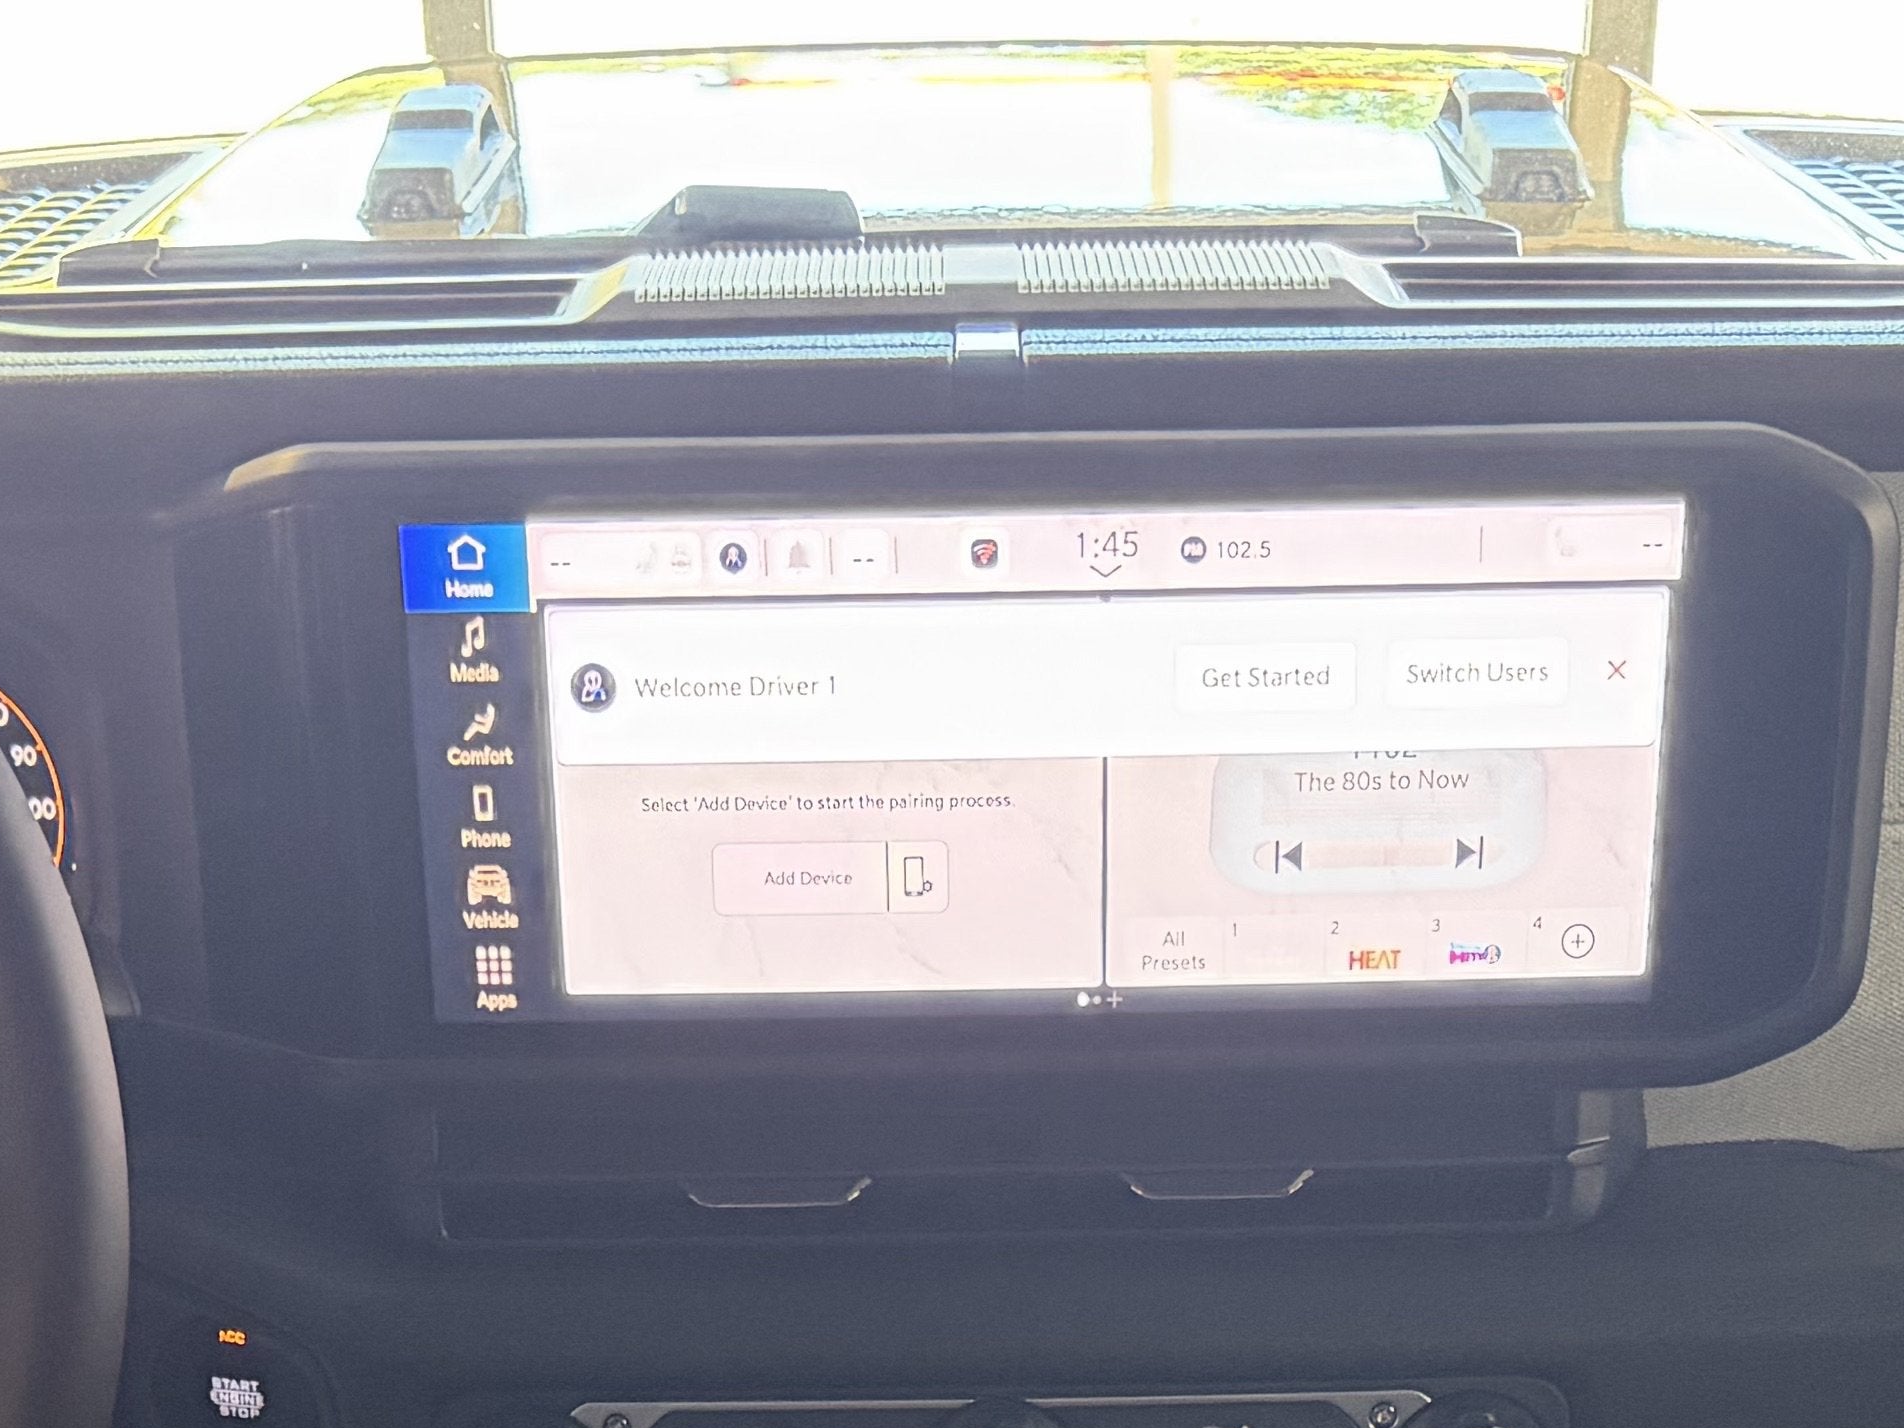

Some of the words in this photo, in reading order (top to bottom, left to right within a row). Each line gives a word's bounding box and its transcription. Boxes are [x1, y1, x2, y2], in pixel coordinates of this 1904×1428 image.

[1075, 530, 1139, 560] 1:45
[1216, 540, 1272, 560] 102.5
[445, 579, 494, 599] Home
[450, 663, 499, 683] Media
[1202, 667, 1243, 689] Get
[1248, 665, 1330, 689] Started
[1406, 662, 1480, 685] Switch
[1487, 662, 1549, 684] Users
[635, 677, 742, 698] Welcome
[749, 675, 820, 697] Driver
[828, 675, 837, 695] 1
[10, 744, 38, 767] 90
[447, 745, 513, 766] Comfort
[1294, 771, 1336, 792] The
[1342, 770, 1382, 791] 80s
[1389, 771, 1411, 791] to
[1418, 769, 1470, 790] Now
[641, 797, 690, 813] Select
[797, 797, 814, 811] to
[817, 796, 855, 811] start
[859, 795, 886, 810] the
[889, 794, 945, 813] pairing
[462, 828, 512, 849] Phone
[765, 871, 796, 887] Add
[800, 871, 854, 887] Device
[463, 910, 520, 931] Vehicle
[1331, 921, 1340, 936] 2
[1432, 918, 1441, 934] 3
[1162, 931, 1186, 948] All
[1141, 954, 1207, 972] Presets
[1348, 949, 1402, 972] HEAT
[477, 990, 518, 1012] Apps
[211, 1376, 260, 1392] START
